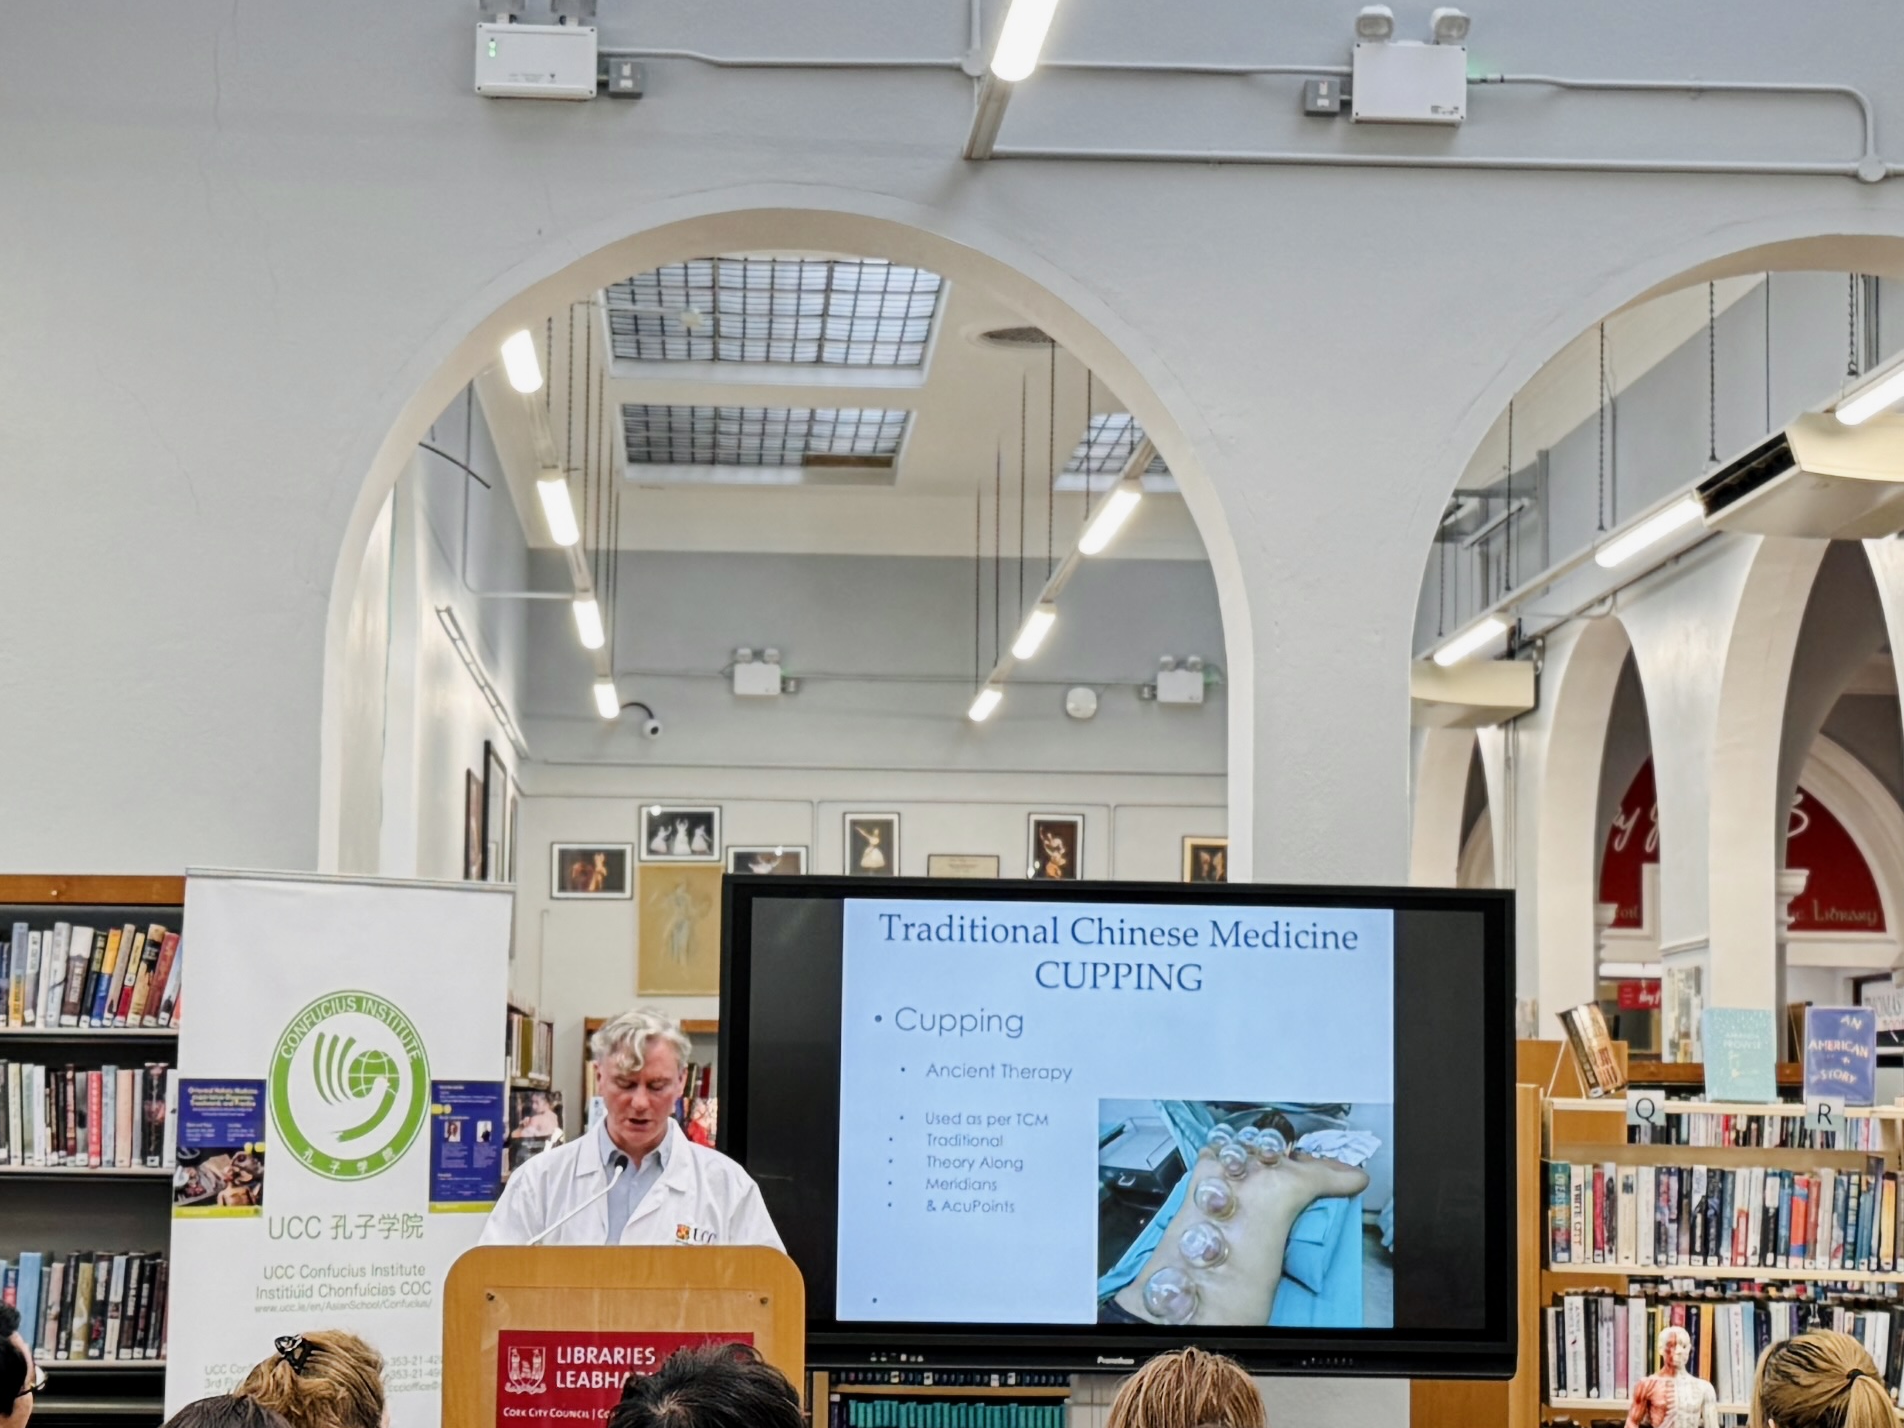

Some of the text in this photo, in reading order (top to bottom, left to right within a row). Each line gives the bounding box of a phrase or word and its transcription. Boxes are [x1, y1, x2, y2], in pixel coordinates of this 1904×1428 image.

[878, 913, 1360, 951] Traditional Chinese Medicine
[1034, 960, 1204, 993] CUPPING
[280, 996, 423, 1063] CONFUCIUS INSTITUTE
[894, 1006, 1025, 1039] Cupping
[1840, 1014, 1863, 1031] AN
[1807, 1039, 1869, 1059] AMERICAN
[925, 1063, 1073, 1083] Ancient Therapy
[1819, 1069, 1857, 1085] STORY
[1634, 1097, 1656, 1123] Q
[1817, 1102, 1833, 1126] R
[924, 1111, 1050, 1131] Used as per TCM
[926, 1133, 1004, 1149] Traditional
[926, 1155, 1024, 1173] Theory Along
[925, 1177, 998, 1192] Meridians
[926, 1199, 1016, 1214] & AcuPoints
[1572, 1183, 1583, 1246] WHITE CITY
[267, 1212, 424, 1241] UCC 孔子学院
[263, 1262, 426, 1280] UCC Confucius Institute
[400, 1280, 432, 1297] COC
[556, 1345, 656, 1365] LIBRARIES
[555, 1370, 646, 1389] LEABHA
